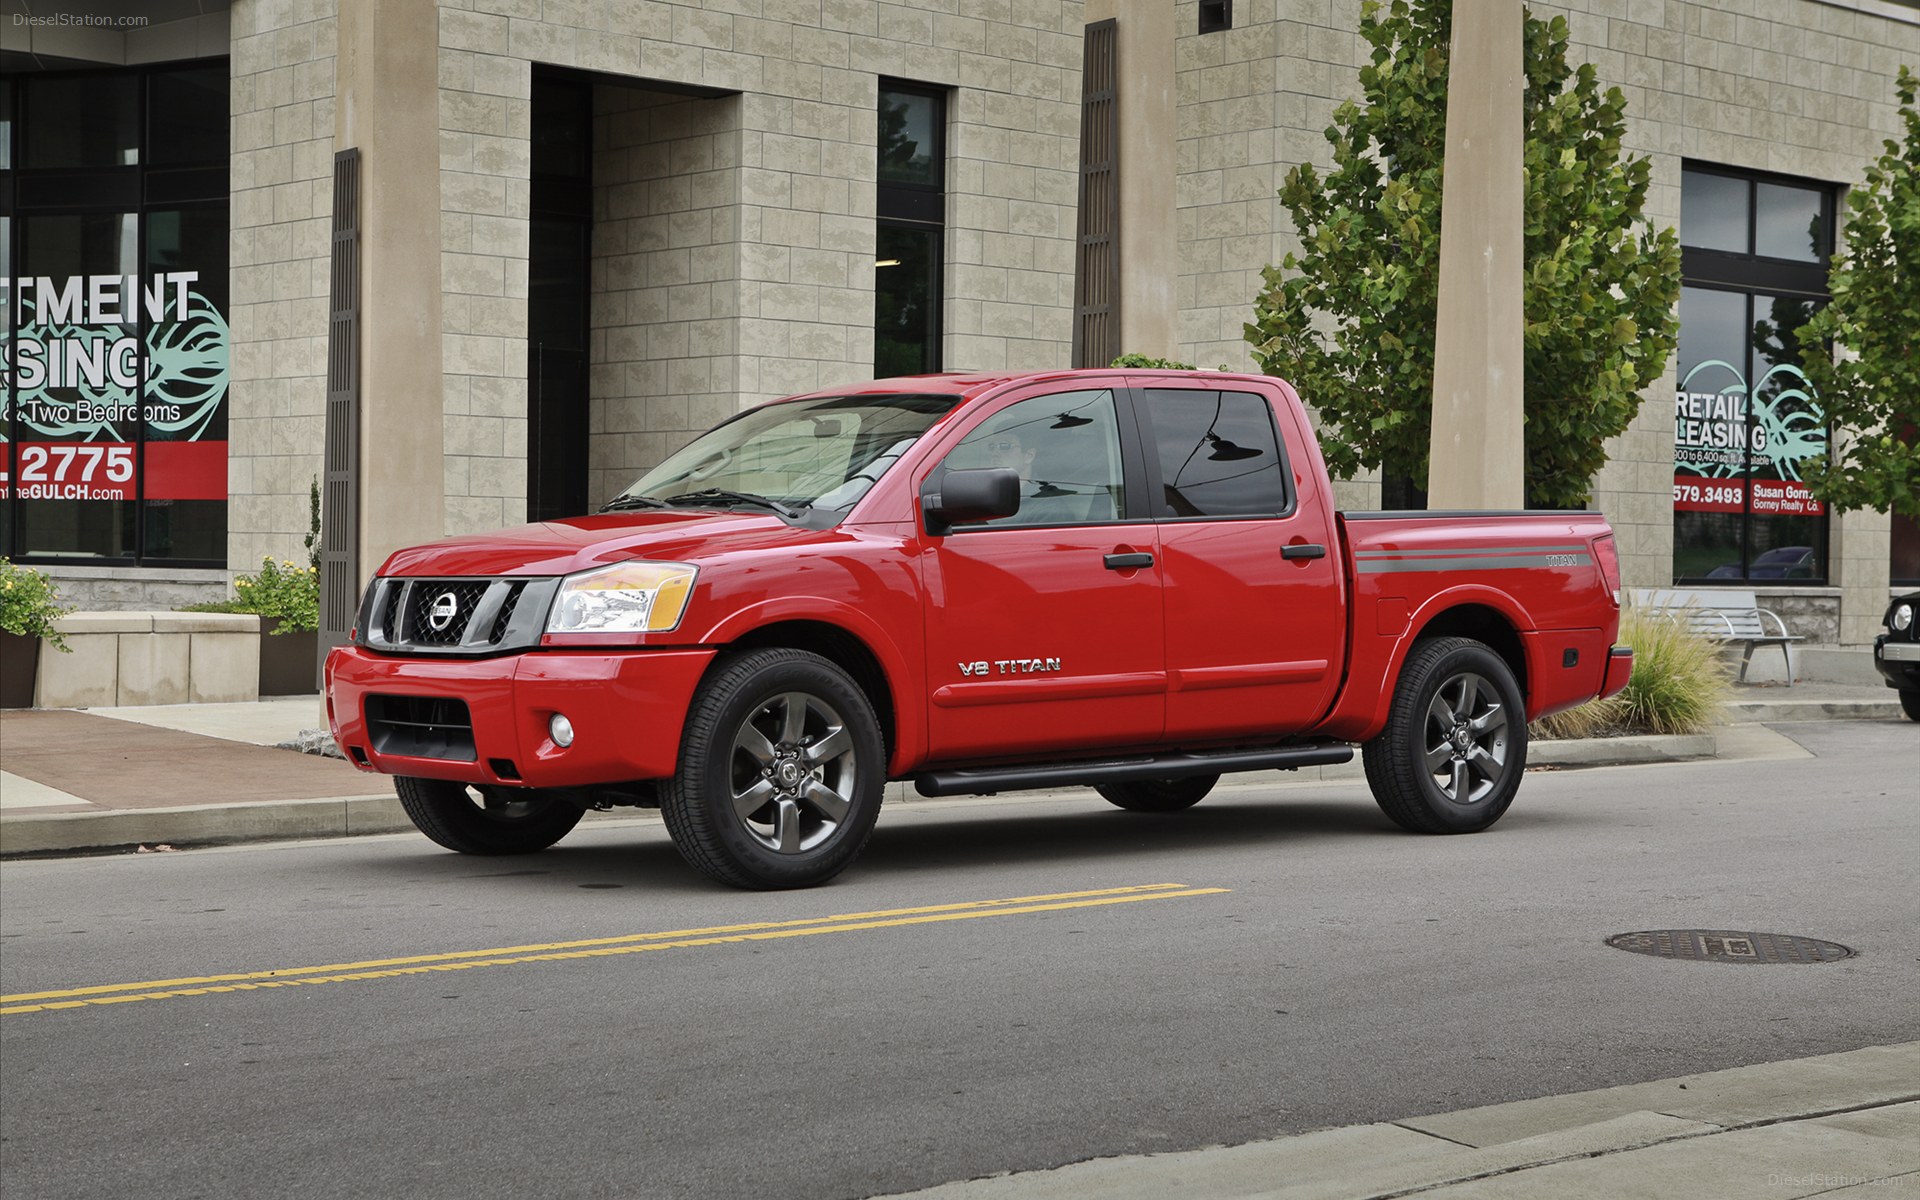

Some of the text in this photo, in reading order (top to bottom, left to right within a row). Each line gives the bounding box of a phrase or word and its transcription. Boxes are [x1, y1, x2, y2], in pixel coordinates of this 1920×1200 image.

[0, 337, 150, 389] SING
[27, 400, 70, 422] Two
[76, 399, 181, 422] Bedrooms
[1676, 391, 1746, 421] RETAIL
[1675, 420, 1766, 450] LEASING
[1673, 485, 1743, 504] 579.3493
[1753, 484, 1814, 499] Susan Gorn
[1753, 498, 1779, 511] Gorney
[1780, 500, 1804, 512] Realty
[1545, 554, 1577, 567] TITAN
[958, 657, 1061, 676] V8 TITAN
